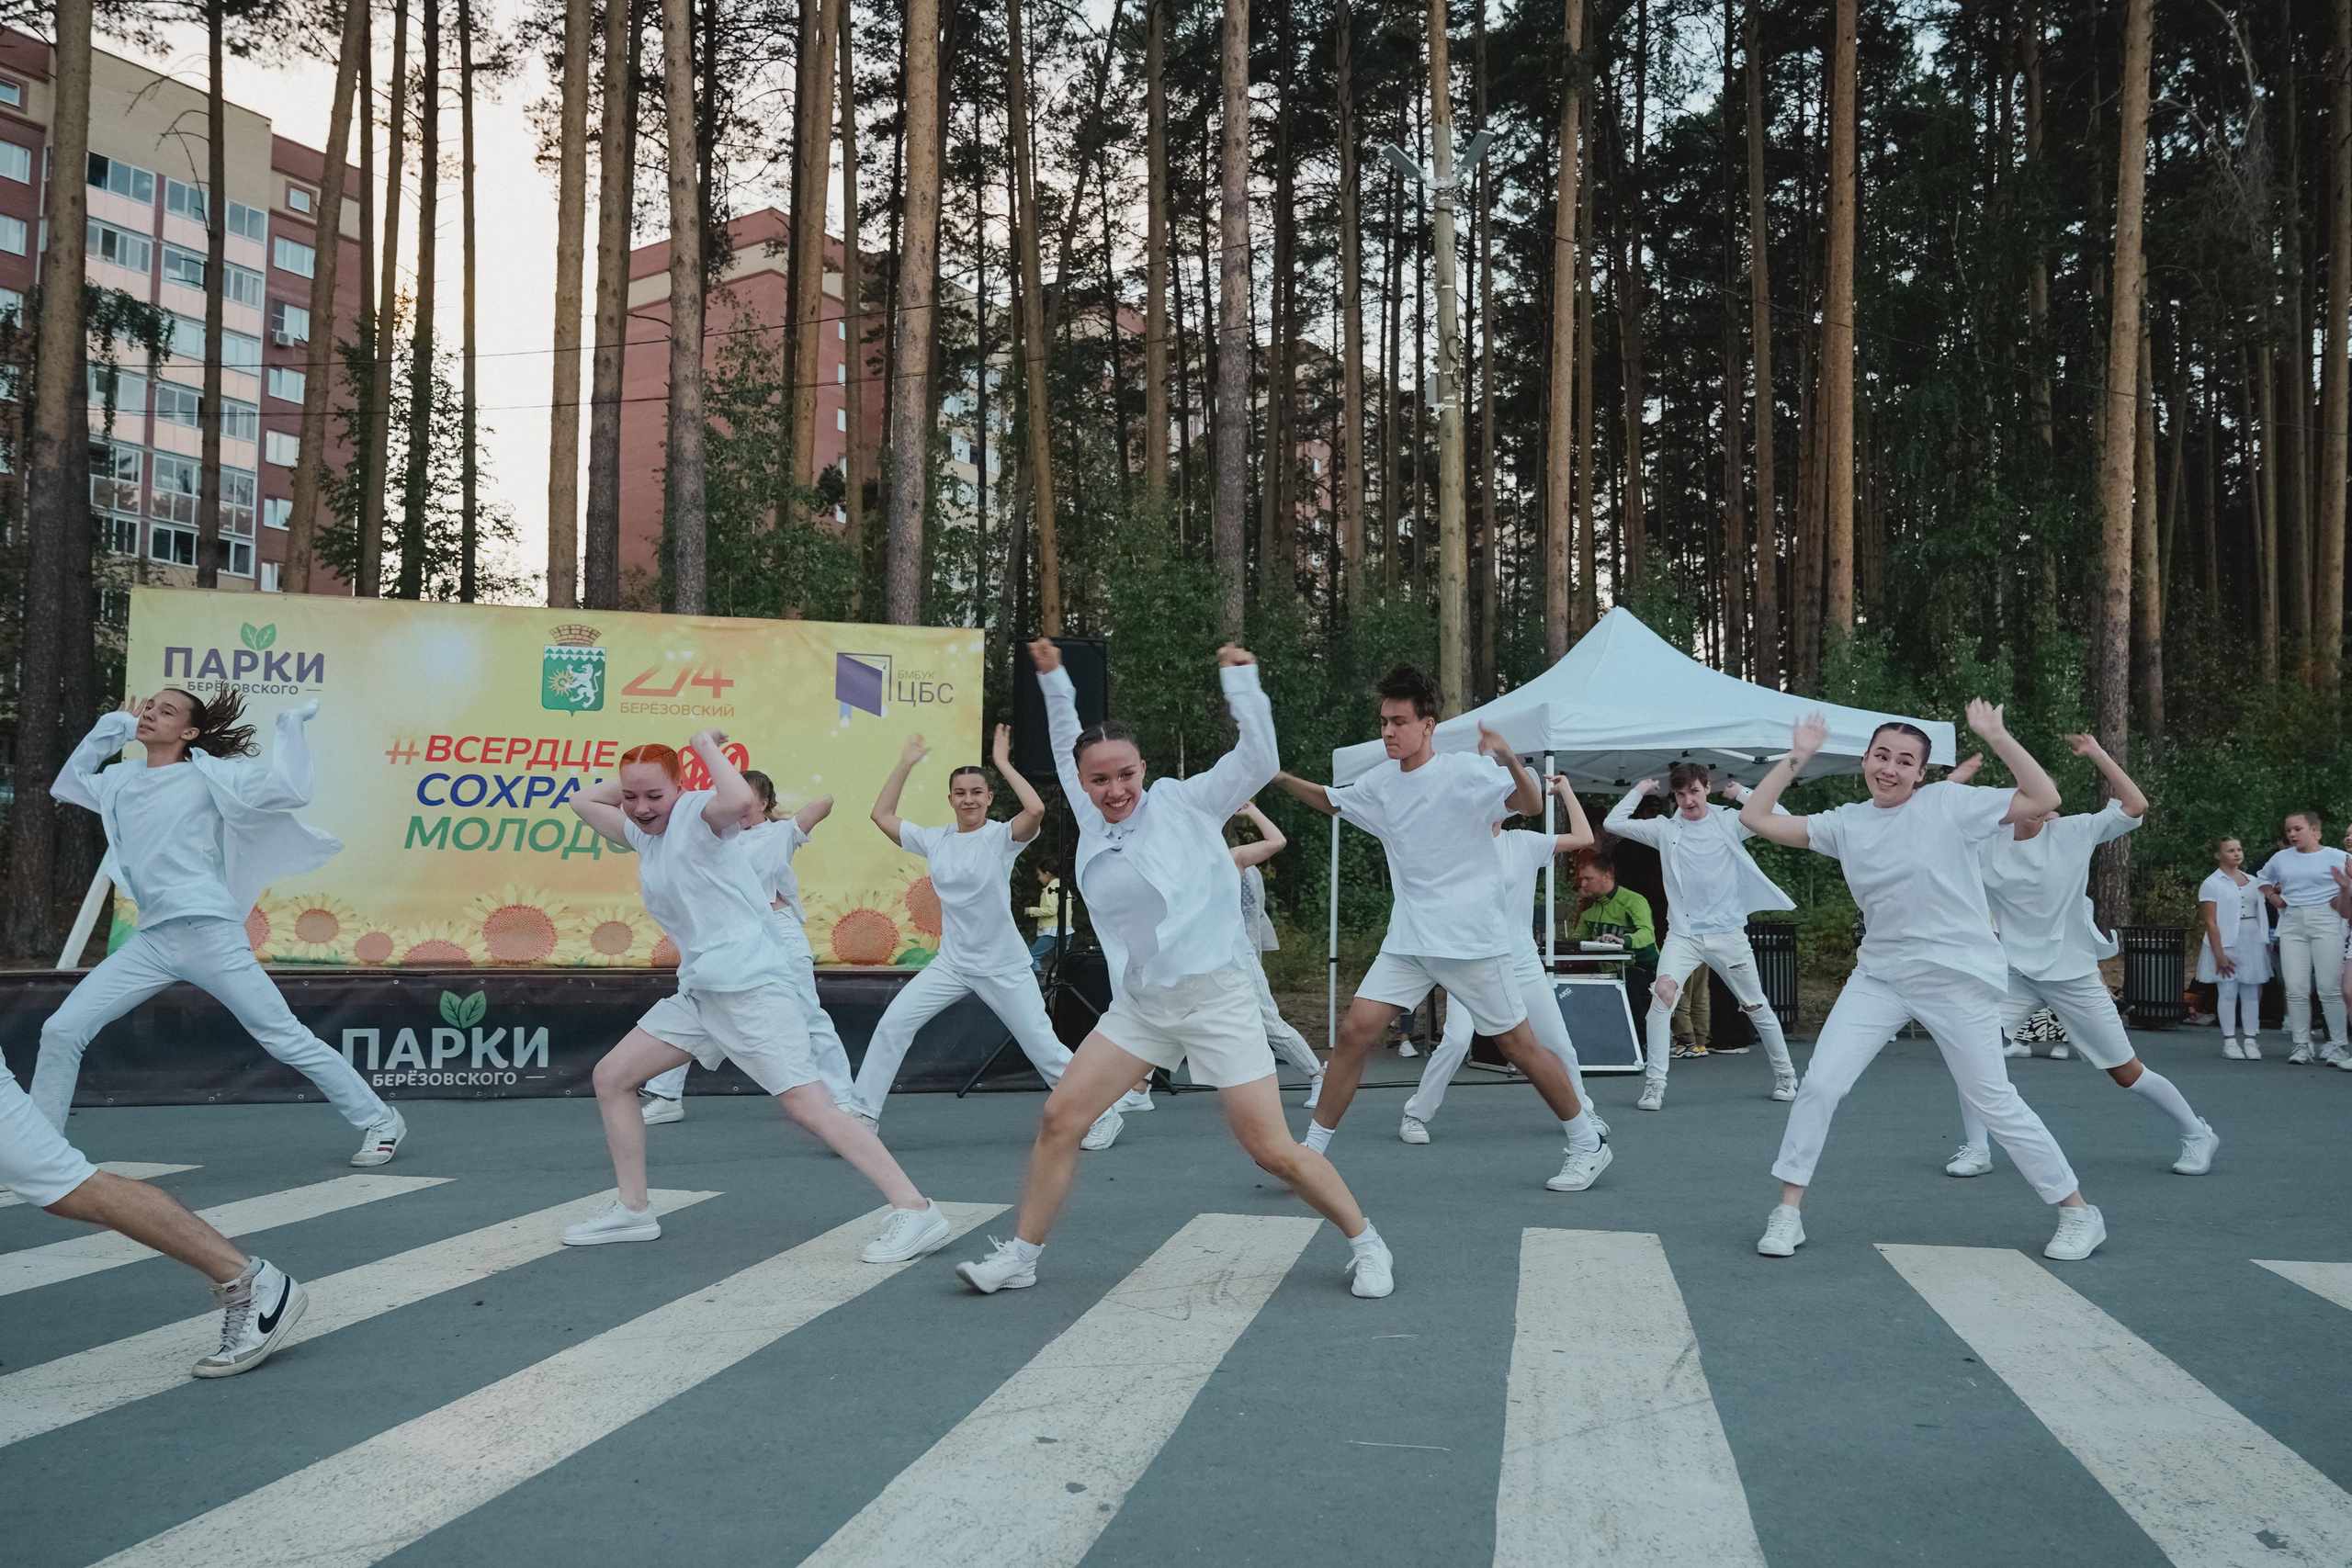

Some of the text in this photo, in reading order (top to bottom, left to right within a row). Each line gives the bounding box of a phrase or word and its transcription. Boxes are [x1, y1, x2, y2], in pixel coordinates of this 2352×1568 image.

[164, 647, 325, 683] ПАРКИ
[898, 670, 935, 681] БМБУК
[898, 681, 955, 707] ЦБС
[620, 701, 734, 717] БЕРЁЗОВСКИЙ
[416, 773, 604, 809] СОХРА
[342, 1026, 549, 1070] ПАРКИ
[372, 1069, 517, 1087] БЕРЁЗОВСКОГО
